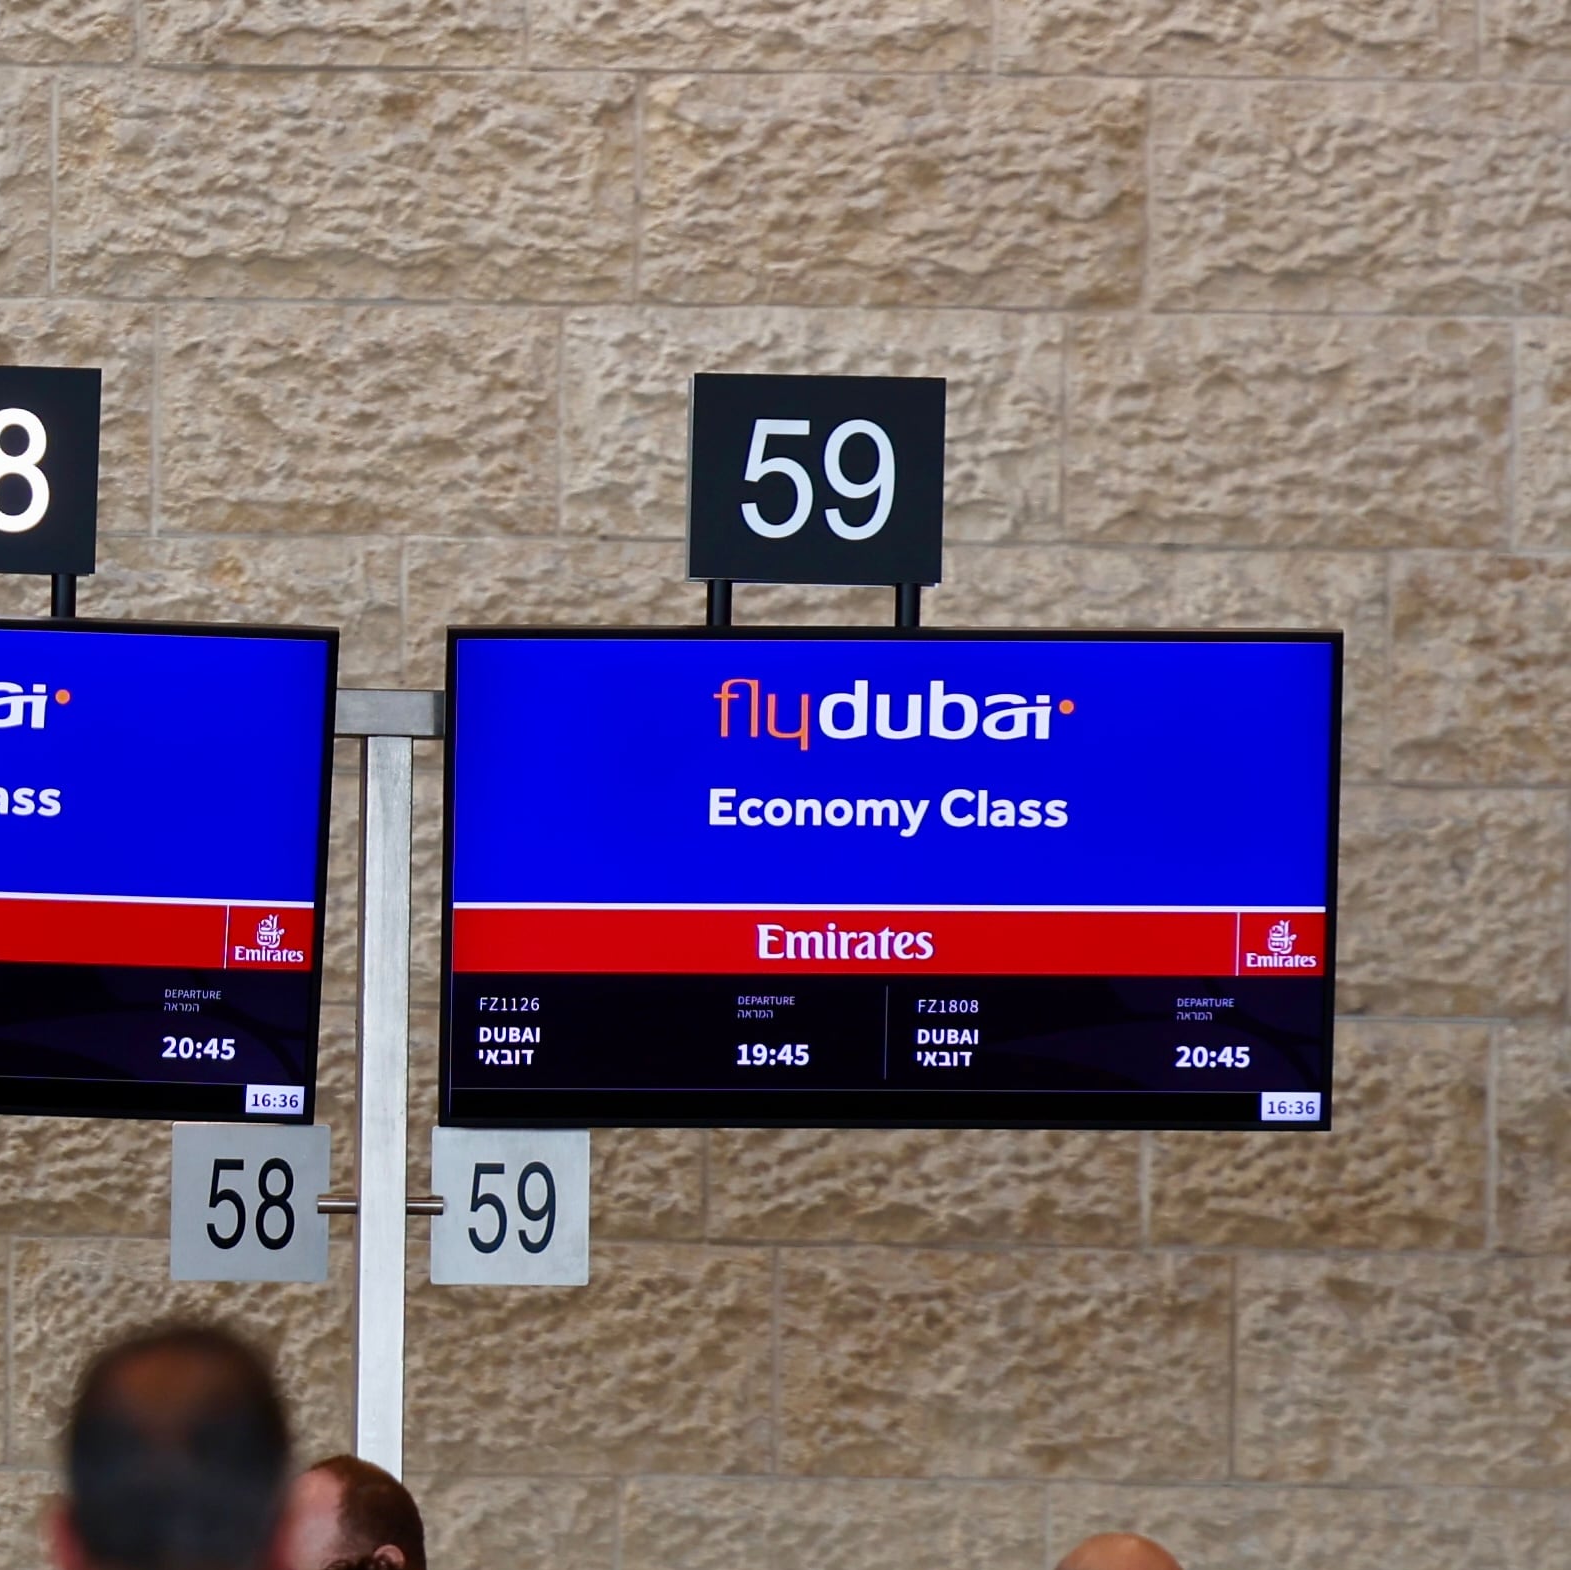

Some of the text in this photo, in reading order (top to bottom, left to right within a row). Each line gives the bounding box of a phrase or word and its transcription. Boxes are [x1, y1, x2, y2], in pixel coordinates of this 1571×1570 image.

[742, 419, 895, 540] 59
[713, 679, 1075, 751] flydubai
[709, 789, 1068, 837] Economy Class
[756, 923, 933, 959] Emirates
[235, 947, 303, 962] Emirates
[1246, 953, 1316, 967] Emirates
[165, 989, 221, 999] DEPARTURE
[738, 996, 795, 1005] DEPARTURE
[480, 997, 539, 1011] FZ1126
[918, 1000, 978, 1013] FZ1808
[1177, 998, 1234, 1007] DEPARTURE
[479, 1027, 540, 1043] DUBAI
[917, 1029, 978, 1044] DUBAI
[162, 1036, 235, 1060] 20:45
[737, 1044, 809, 1065] 19:45
[479, 1050, 534, 1064] דובאי
[917, 1051, 972, 1066] דובאי
[1175, 1046, 1250, 1068] 20:45
[252, 1094, 298, 1108] 16:36
[1268, 1101, 1315, 1114] 16:36
[207, 1158, 294, 1250] 58
[468, 1162, 556, 1253] 59
